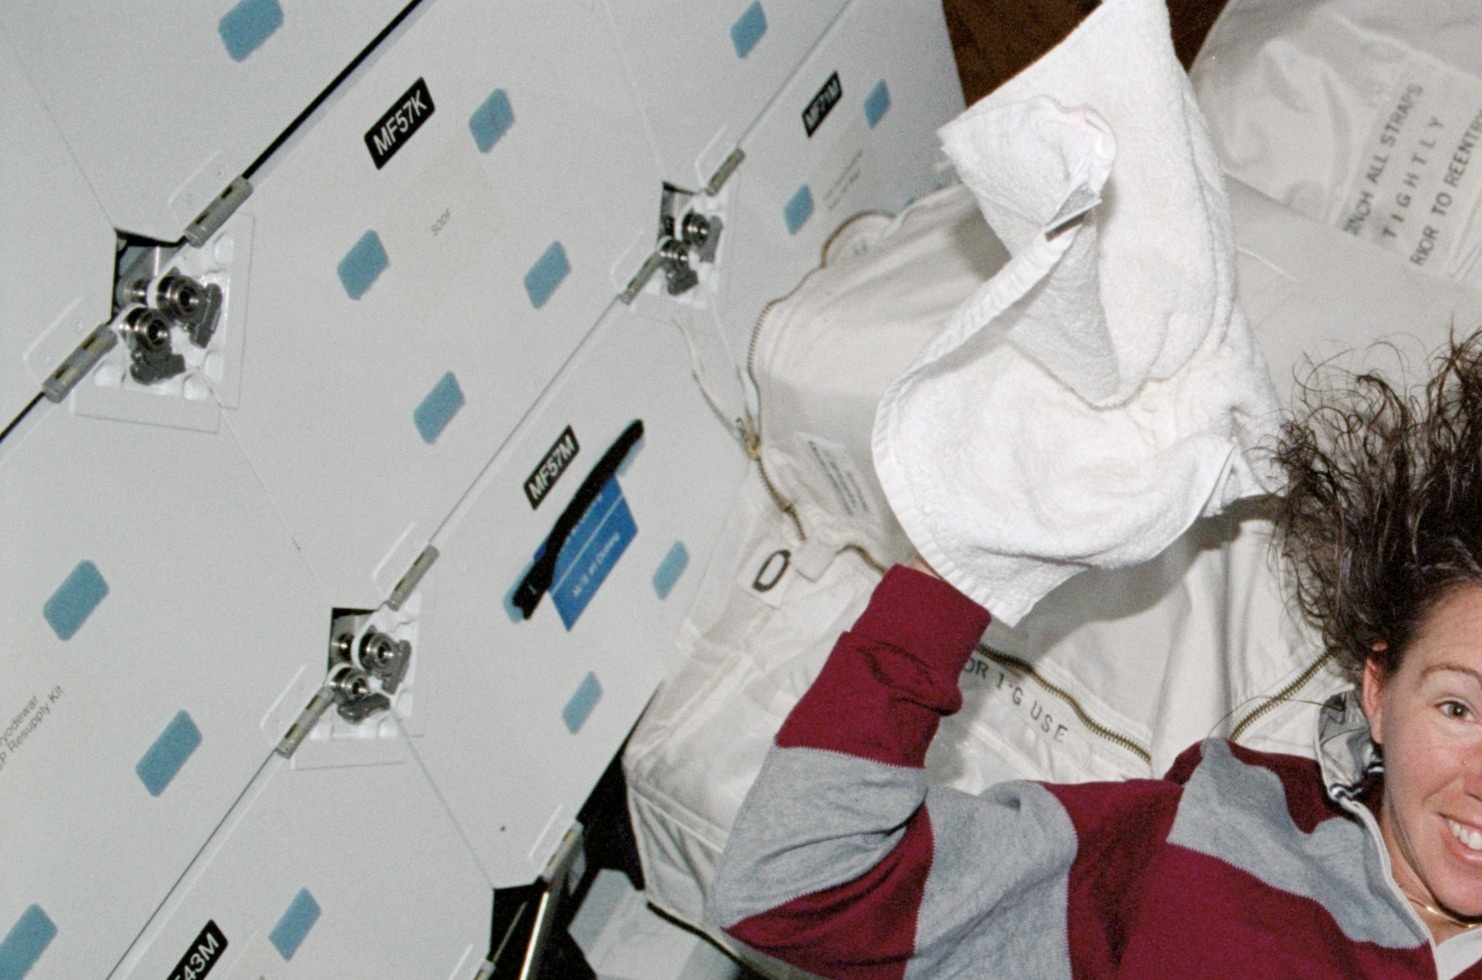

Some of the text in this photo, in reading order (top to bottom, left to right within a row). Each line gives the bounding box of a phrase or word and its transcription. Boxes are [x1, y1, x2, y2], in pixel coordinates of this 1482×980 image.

[373, 90, 428, 155] MF57K
[1366, 155, 1389, 185] ALL
[1380, 84, 1424, 148] STRAPS
[1409, 225, 1439, 267] RIOR
[1431, 191, 1453, 217] TO
[527, 434, 576, 500] MF57M
[0, 695, 38, 747] ryodewar
[7, 702, 51, 753] Resupply
[48, 685, 64, 704] Kit
[964, 658, 988, 680] OR
[1030, 701, 1068, 744] USE
